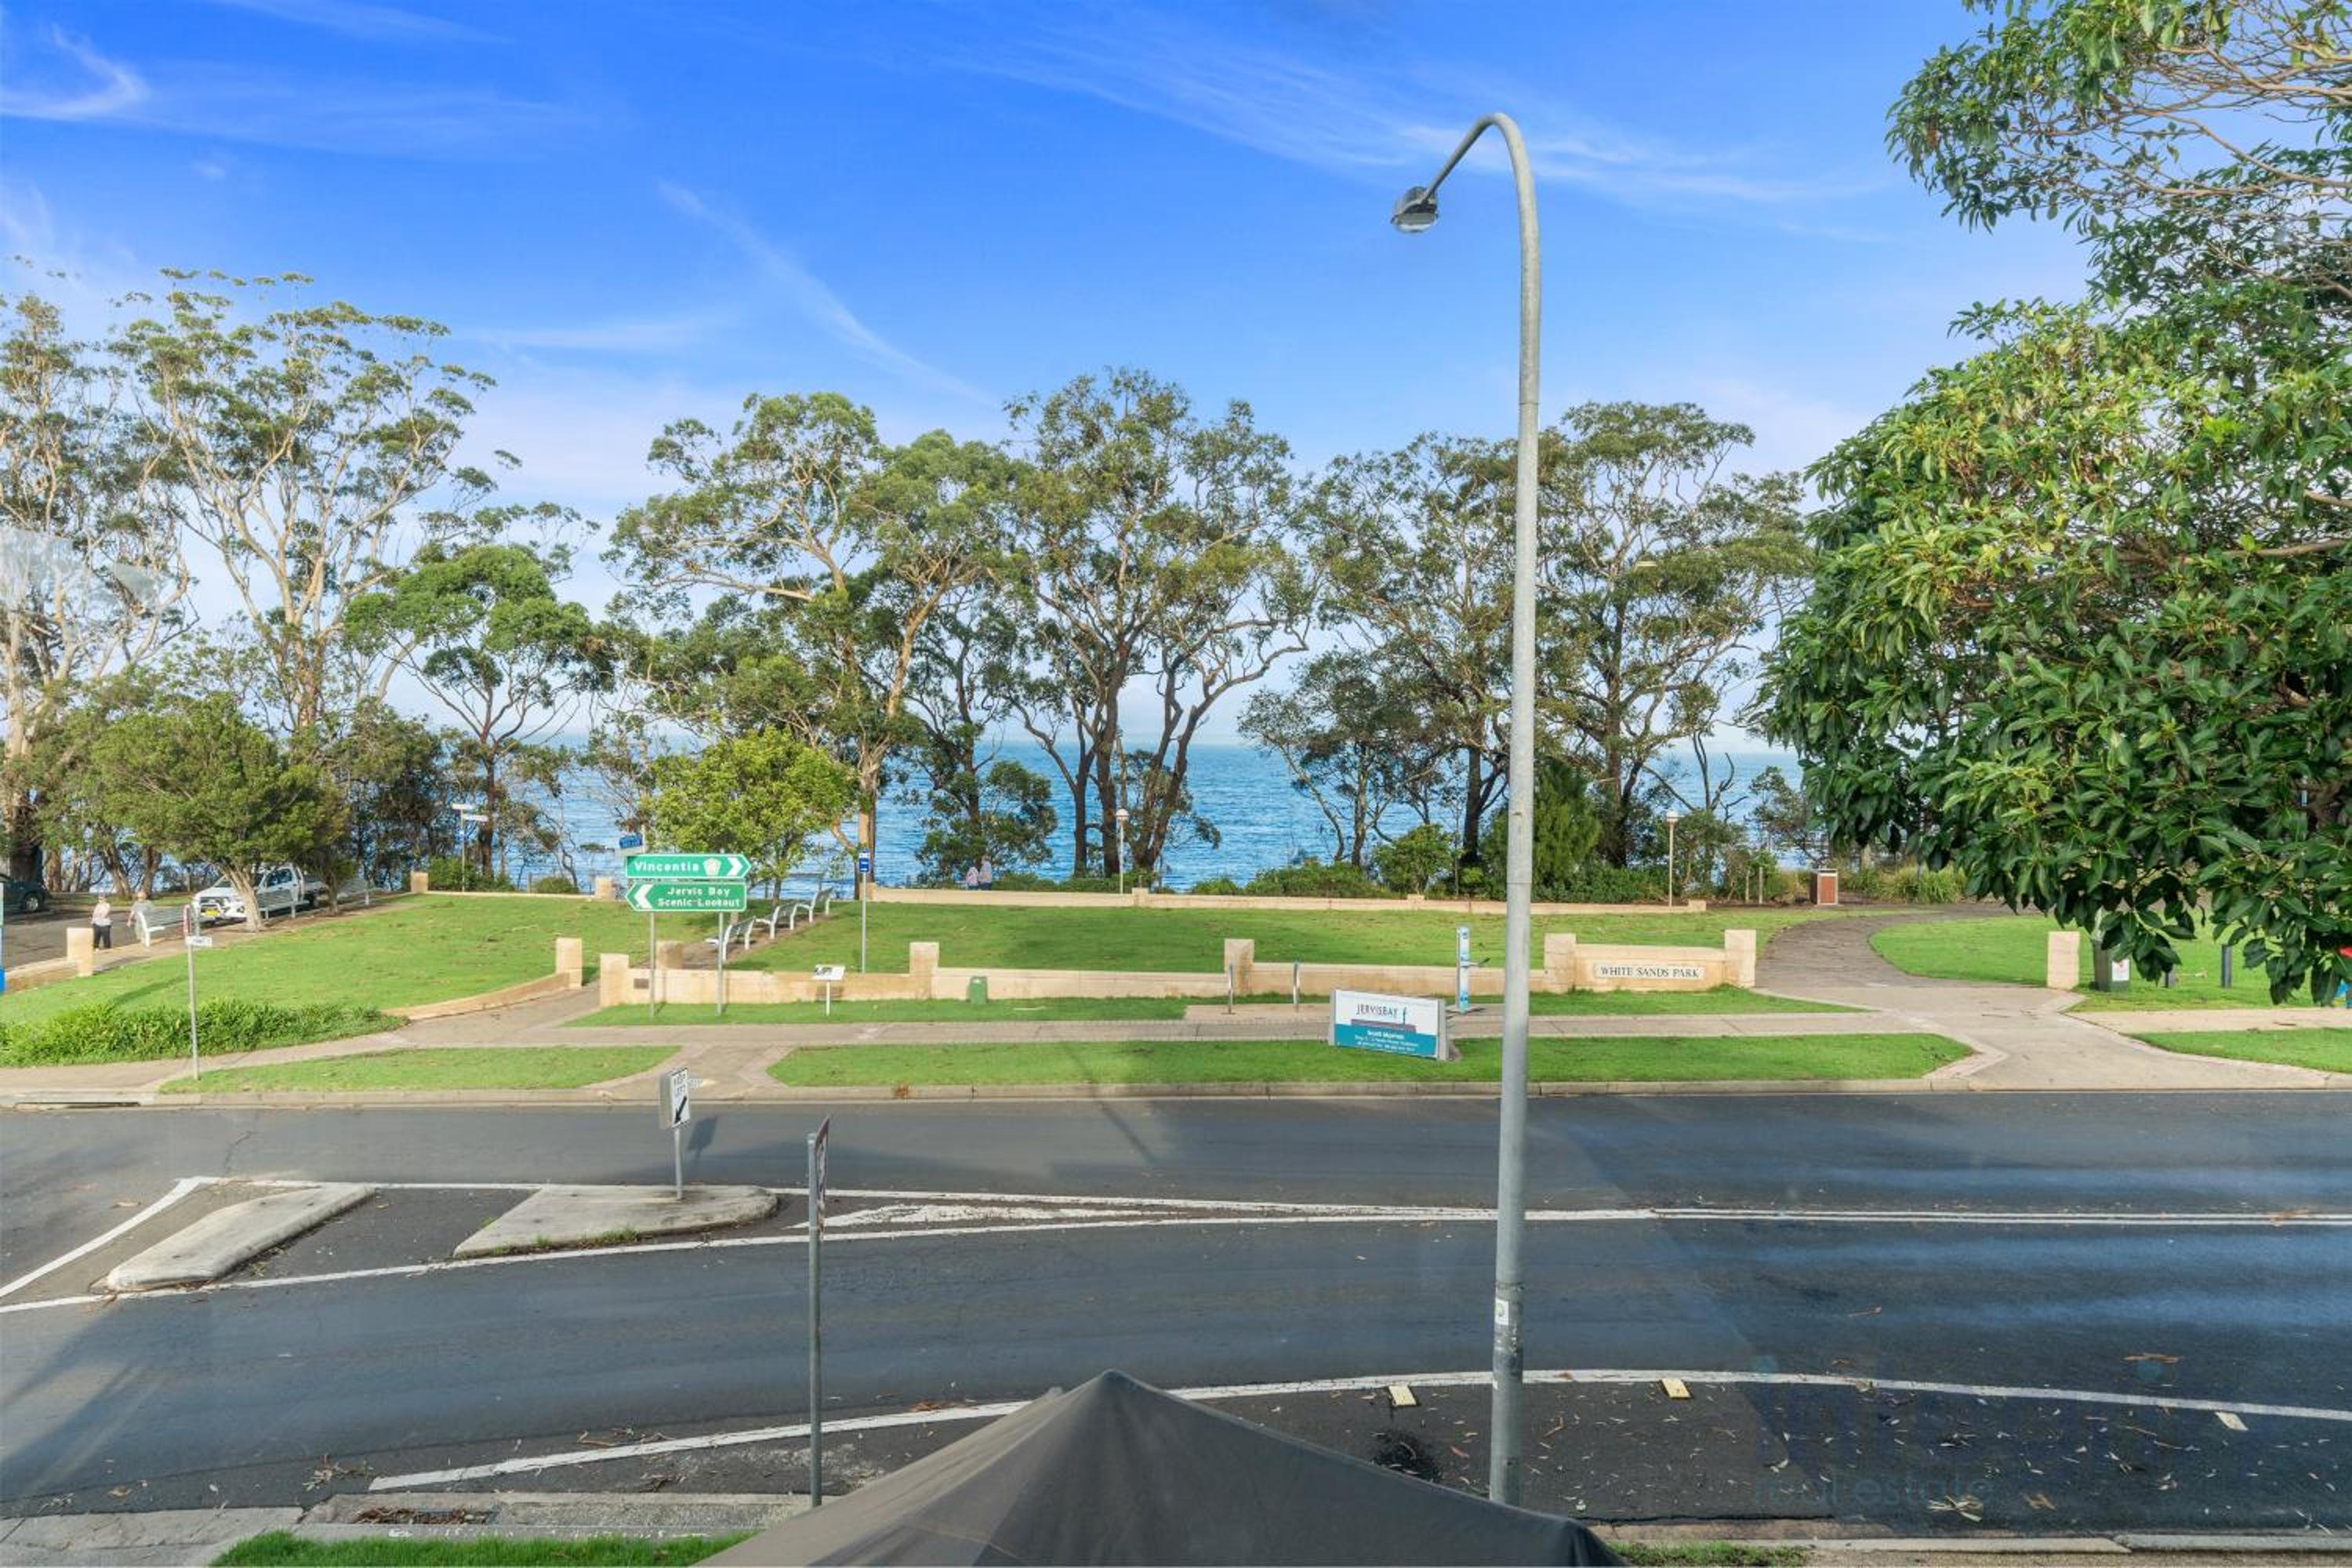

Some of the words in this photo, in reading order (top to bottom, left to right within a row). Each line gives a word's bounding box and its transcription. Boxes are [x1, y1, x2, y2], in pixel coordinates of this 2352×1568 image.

[634, 862, 699, 872] Vincentia
[668, 887, 703, 896] Jervis
[708, 887, 731, 898] Bay
[658, 898, 693, 907] Scenic
[698, 898, 741, 907] Lookout
[1600, 967, 1632, 977] WHITE
[1637, 967, 1669, 978] SANDS
[1673, 968, 1700, 978] PARK
